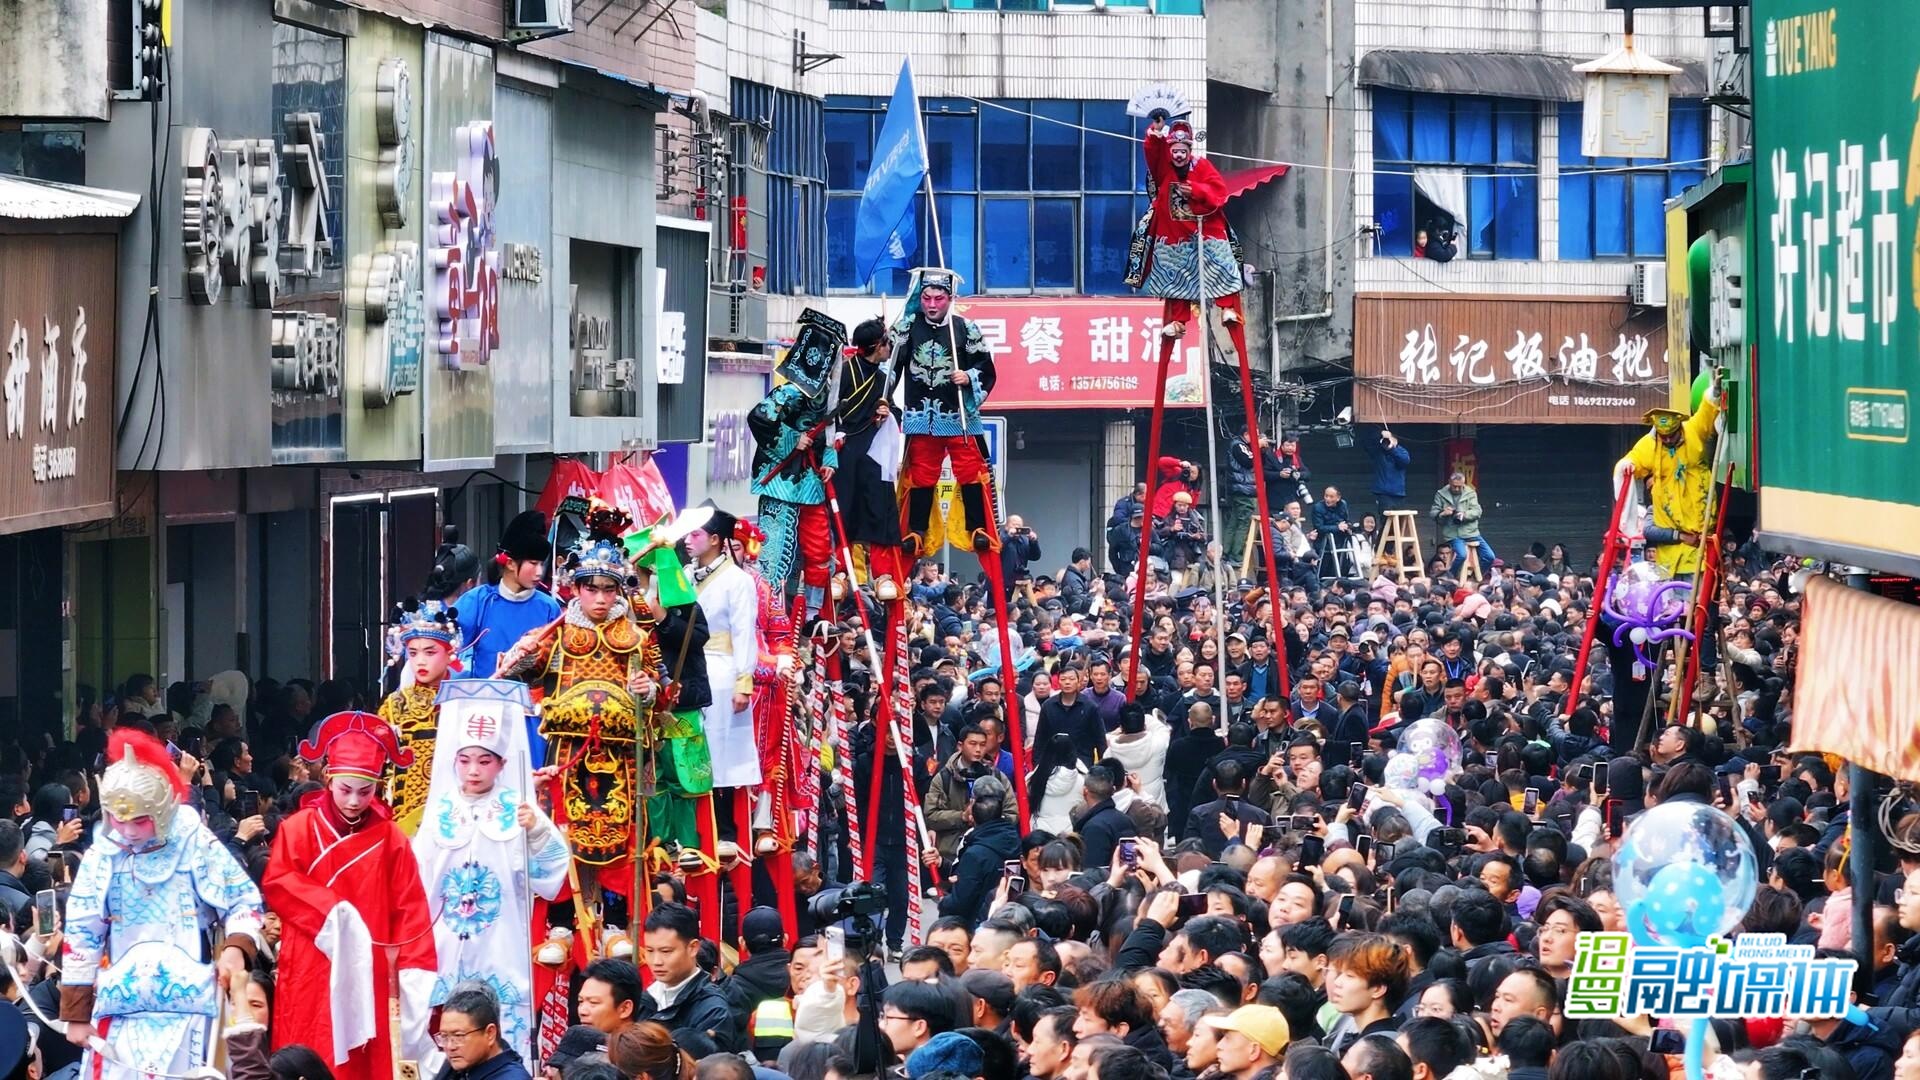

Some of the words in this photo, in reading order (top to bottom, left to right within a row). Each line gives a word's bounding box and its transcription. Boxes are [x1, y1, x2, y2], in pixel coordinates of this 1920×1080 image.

[1777, 16, 1802, 76] YUE
[1803, 8, 1837, 71] YANG
[1771, 133, 1900, 346] 许记超市
[973, 316, 1064, 365] 早餐
[1399, 322, 1669, 386] 张记板油批
[1549, 395, 1570, 406] 电话
[1574, 396, 1636, 406] 18692173760
